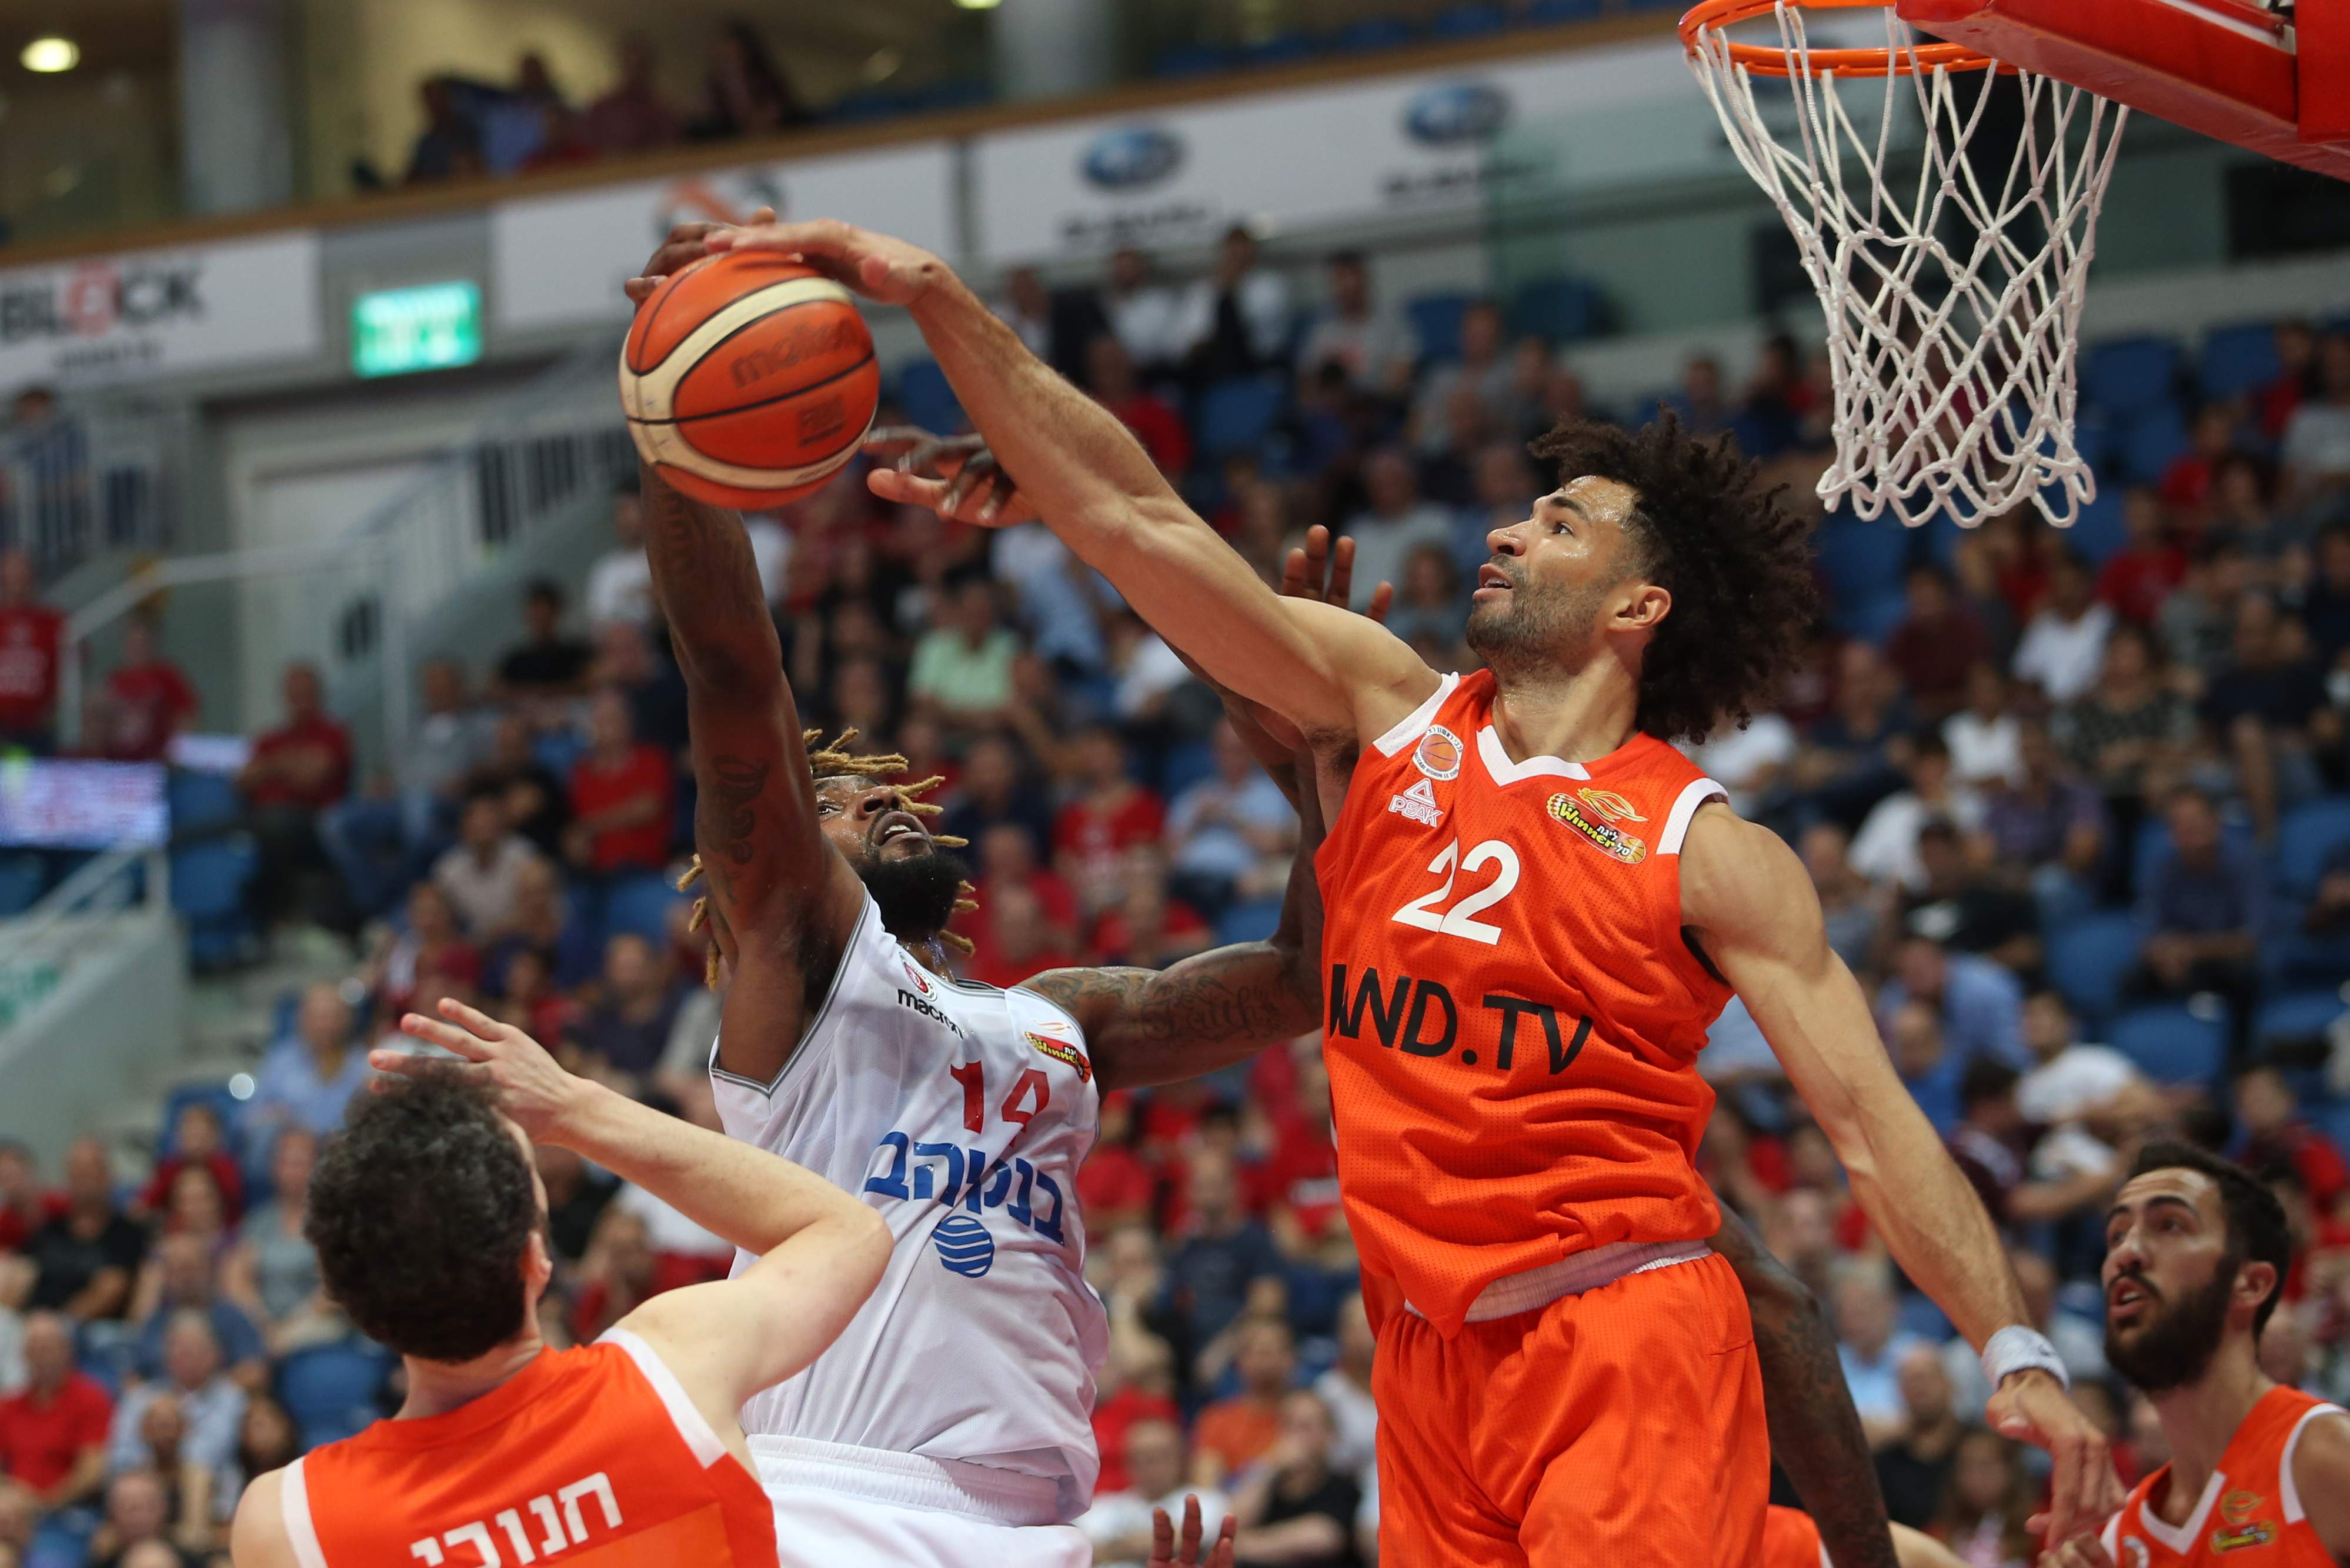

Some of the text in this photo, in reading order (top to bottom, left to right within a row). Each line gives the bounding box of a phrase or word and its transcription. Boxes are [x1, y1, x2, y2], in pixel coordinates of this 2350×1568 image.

[1388, 795, 1444, 828] PEAK
[1558, 801, 1631, 856] Winner סל
[1596, 825, 1619, 842] ליגת
[1391, 836, 1520, 946] 22
[897, 989, 964, 1040] macron
[950, 1060, 1051, 1147] 14
